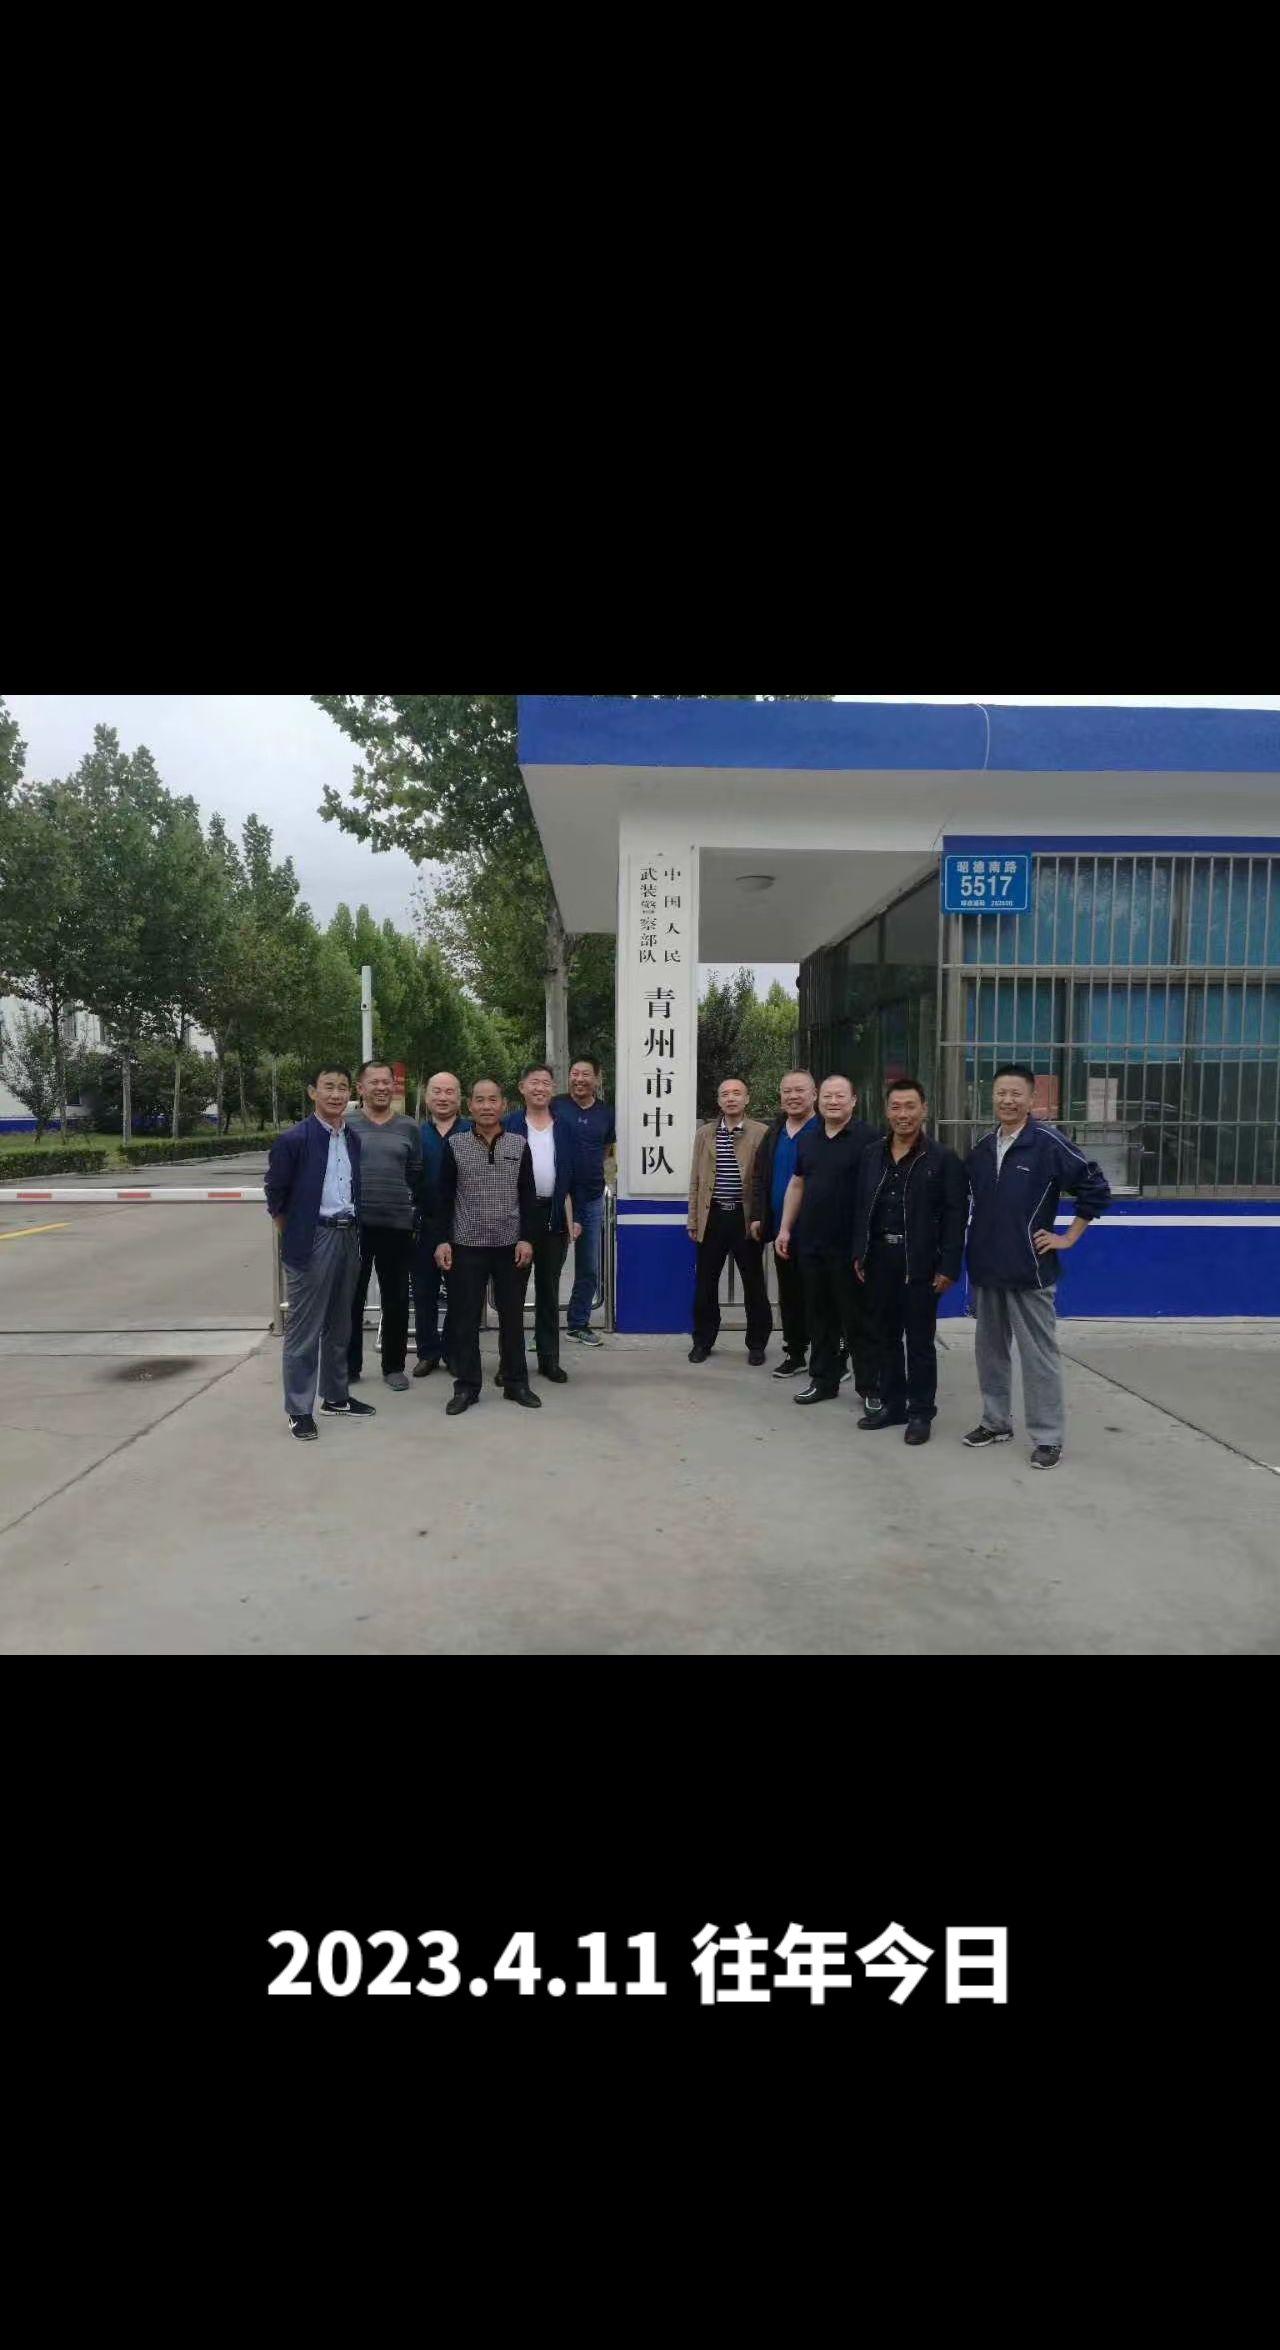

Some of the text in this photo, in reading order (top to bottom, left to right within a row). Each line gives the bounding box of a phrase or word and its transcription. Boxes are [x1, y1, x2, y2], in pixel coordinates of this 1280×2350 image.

[639, 867, 657, 963] 武装警察部队
[664, 867, 681, 963] 中国人民
[956, 861, 1017, 873] 昭德南路
[960, 875, 1013, 896] 5517
[641, 987, 676, 1175] 青州市中队
